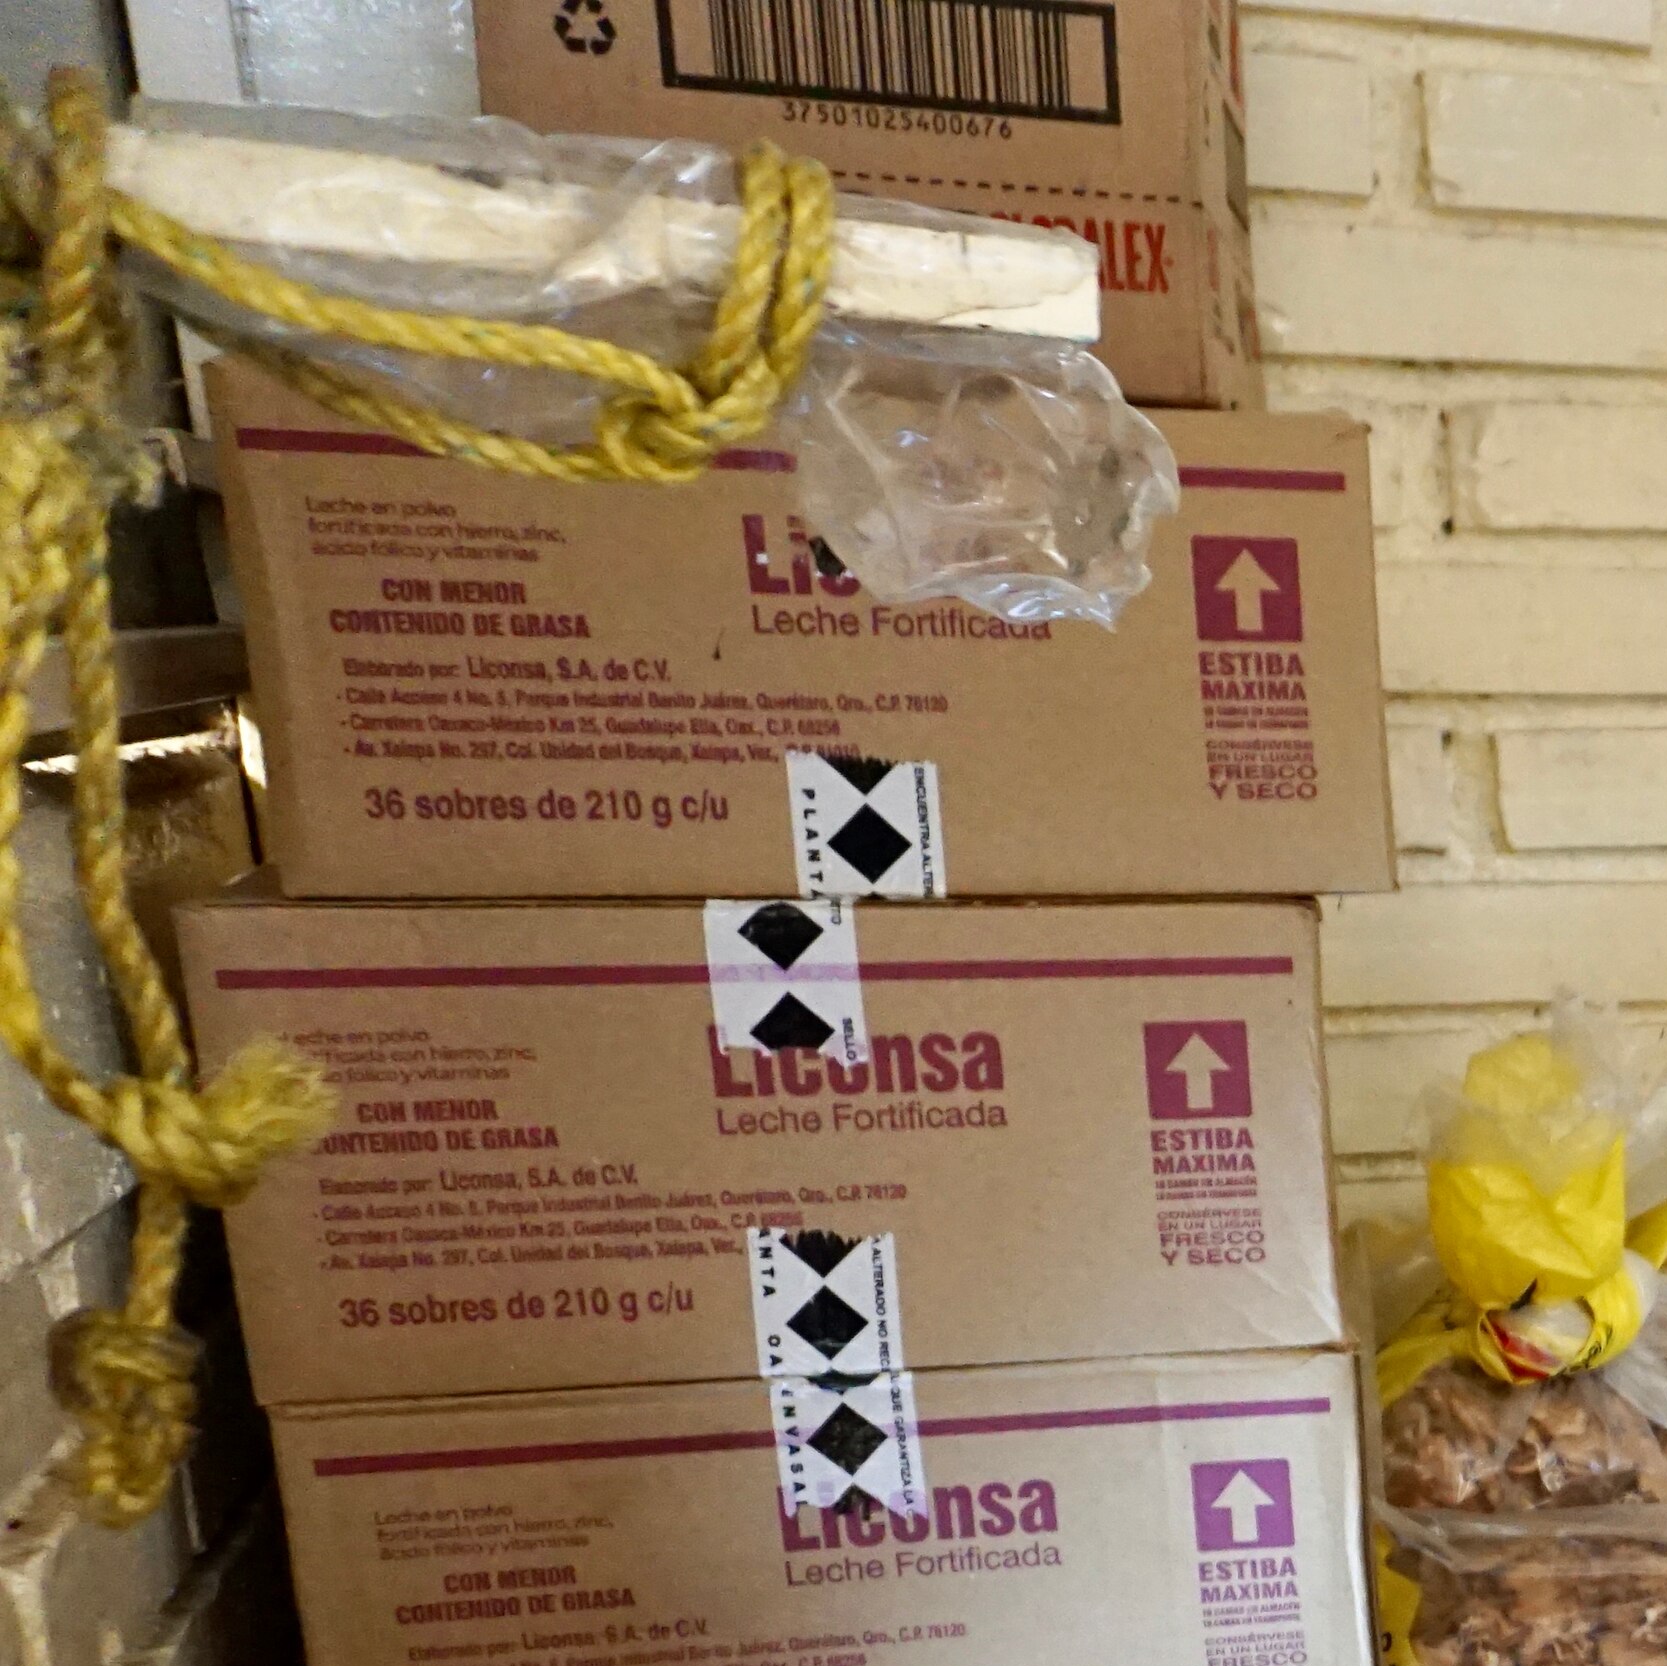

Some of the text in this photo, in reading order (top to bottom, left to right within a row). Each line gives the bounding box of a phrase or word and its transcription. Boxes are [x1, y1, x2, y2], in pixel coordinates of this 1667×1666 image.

[782, 99, 1014, 140] 37501025400676
[381, 577, 527, 604] CON MENOR
[329, 608, 592, 638] CONTENIDO DE GRASA
[751, 604, 1052, 641] Leche Fortificada
[603, 660, 630, 681] de
[1198, 650, 1306, 677] ESTIBA
[1200, 679, 1308, 701] MAXIMA
[1208, 764, 1319, 780] FRESCO
[1208, 782, 1319, 800] Y SECO
[365, 786, 729, 829] 36 sobres de 210 g c/u
[357, 1099, 500, 1123] CON MENOR
[716, 1098, 1009, 1137] Leche Fortificada
[445, 1125, 561, 1151] DE GRASA
[1150, 1127, 1255, 1153] ESTIBA
[572, 1164, 598, 1186] de
[1152, 1153, 1257, 1176] MAXIMA
[1159, 1230, 1266, 1248] FRESCO
[1160, 1247, 1268, 1267] Y SECO
[339, 1281, 695, 1328] 36 sobres de 210 g c/u
[783, 1541, 1063, 1588] Leche Fortificada
[1198, 1556, 1298, 1582] ESTIBA
[442, 1563, 577, 1595] CON MENOR
[394, 1586, 637, 1625] CONTENIDO DE GRASA
[1200, 1581, 1299, 1604] MAXIMA
[927, 1623, 967, 1640] 76120
